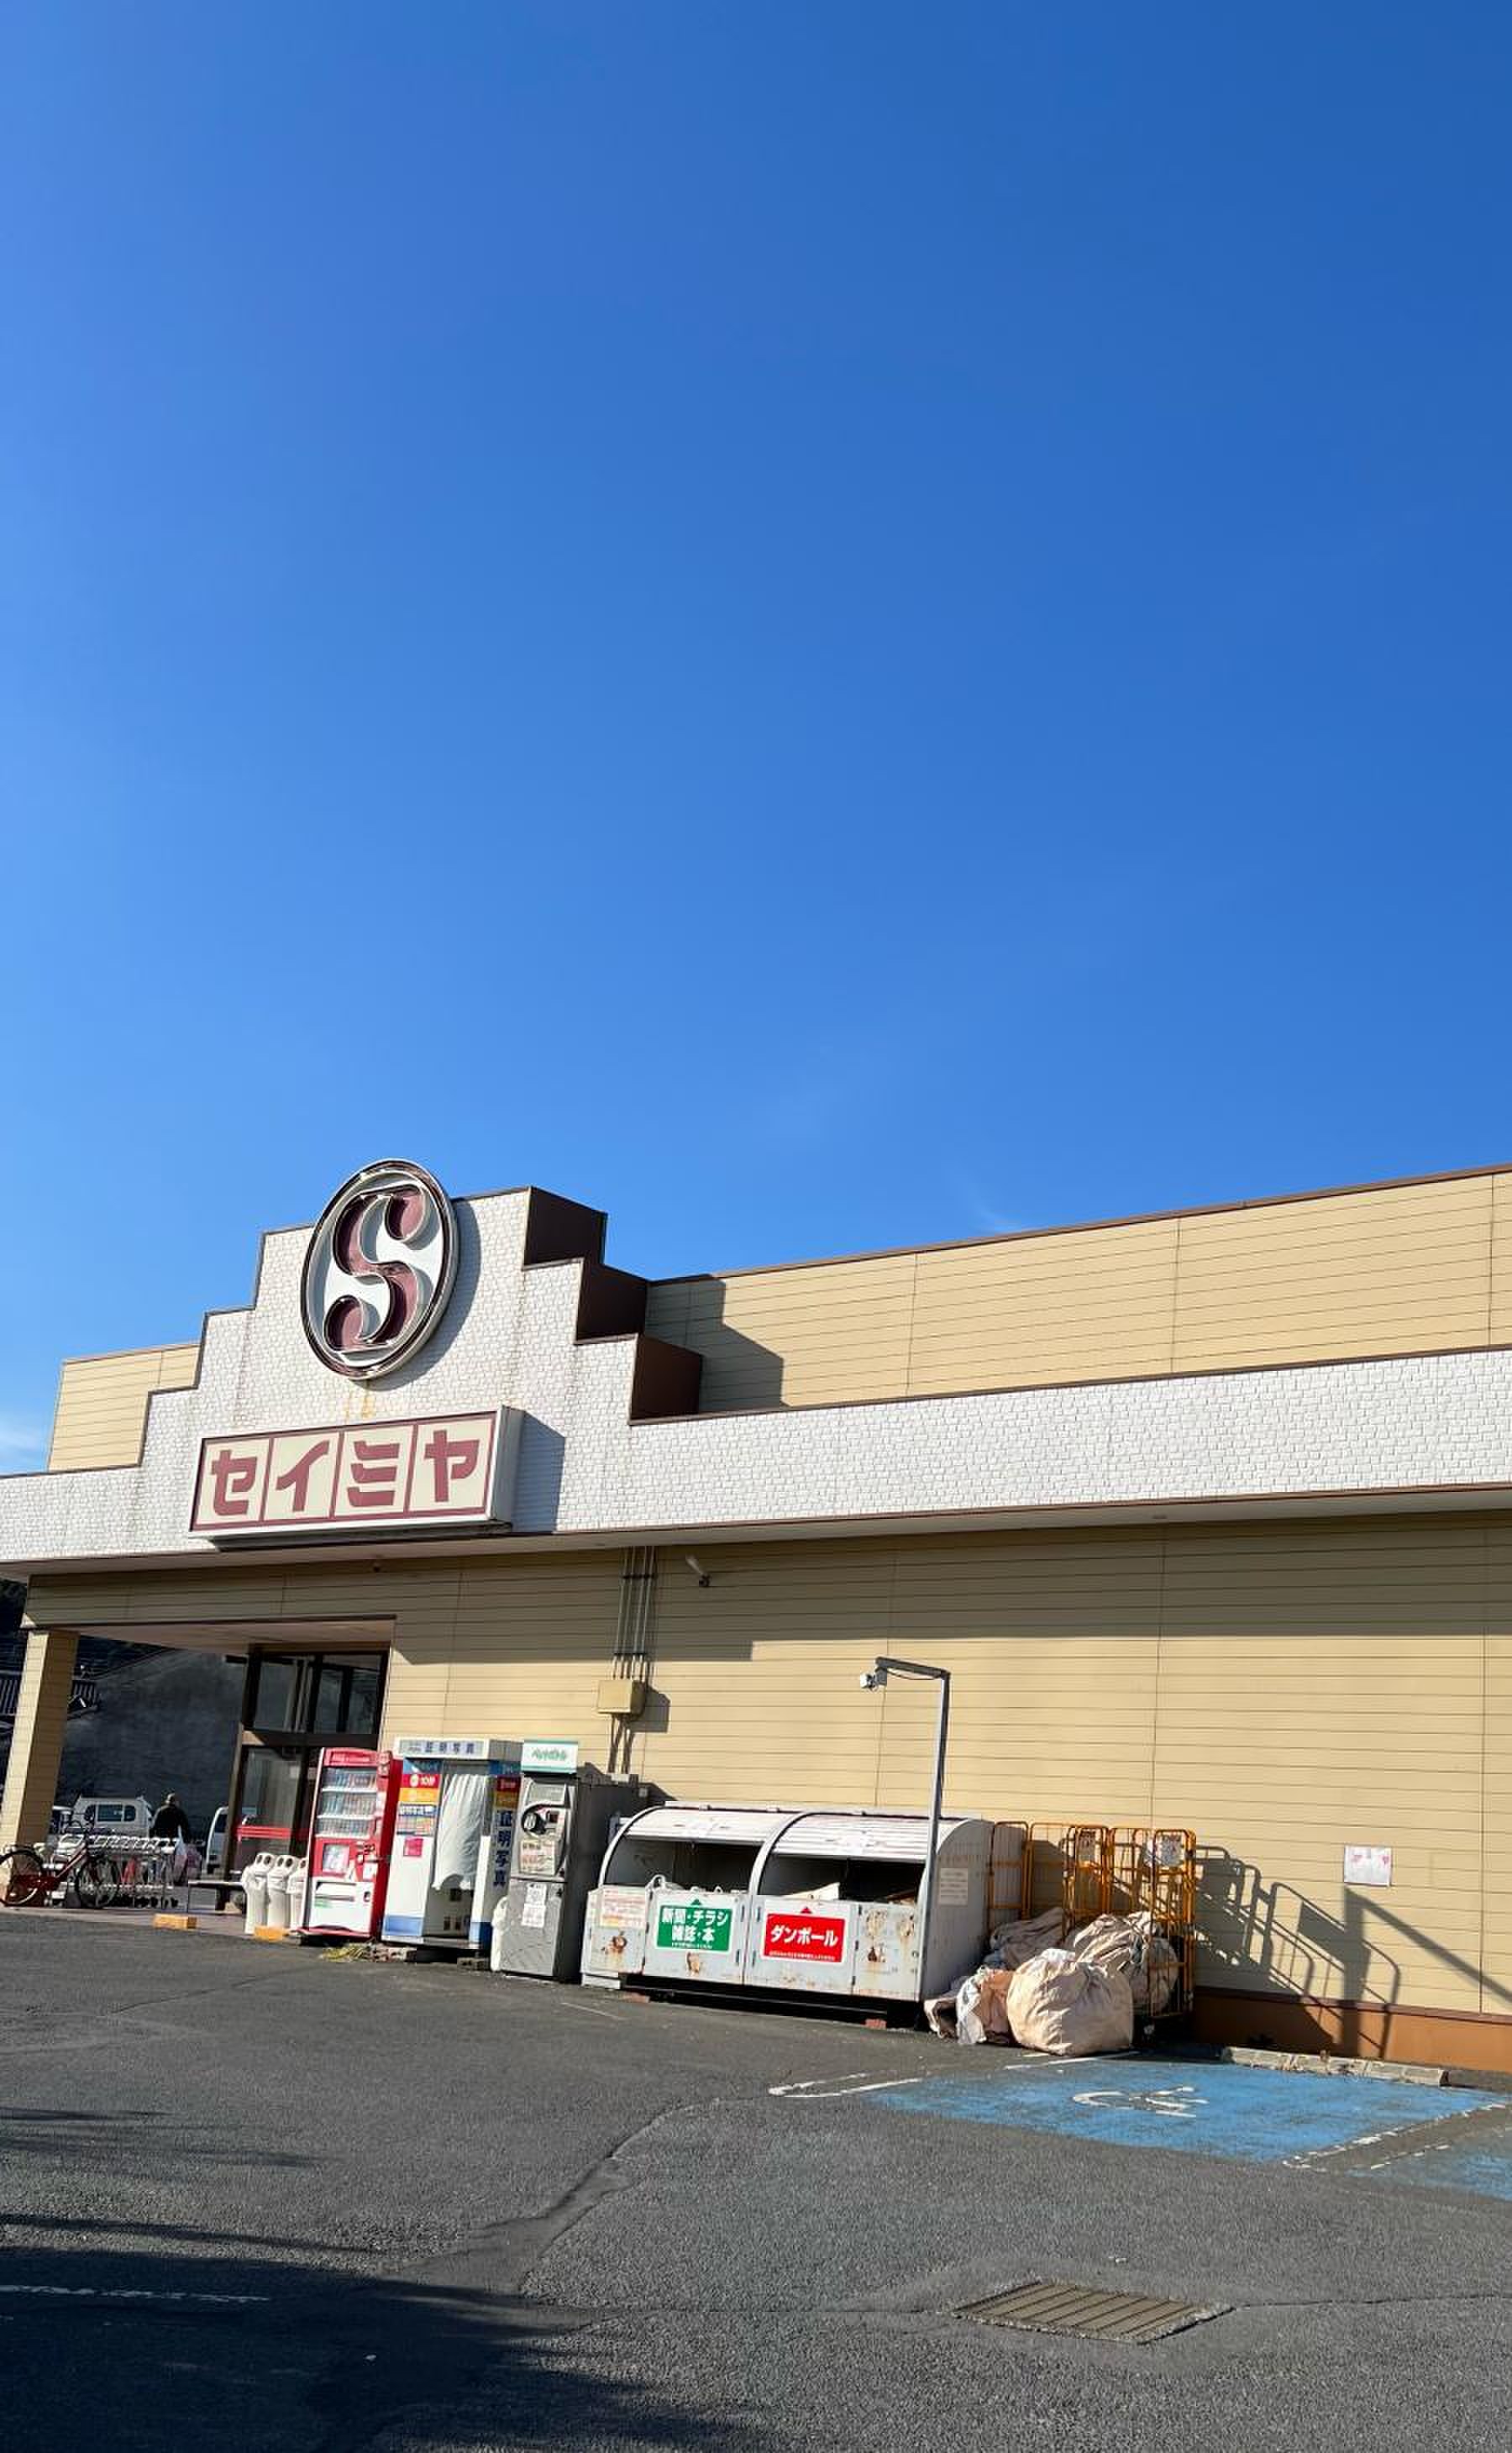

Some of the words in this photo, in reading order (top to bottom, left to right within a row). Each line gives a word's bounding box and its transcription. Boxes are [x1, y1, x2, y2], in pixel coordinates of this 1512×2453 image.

[211, 1430, 480, 1516] セイミヤ
[771, 1925, 838, 1946] ダンボール
